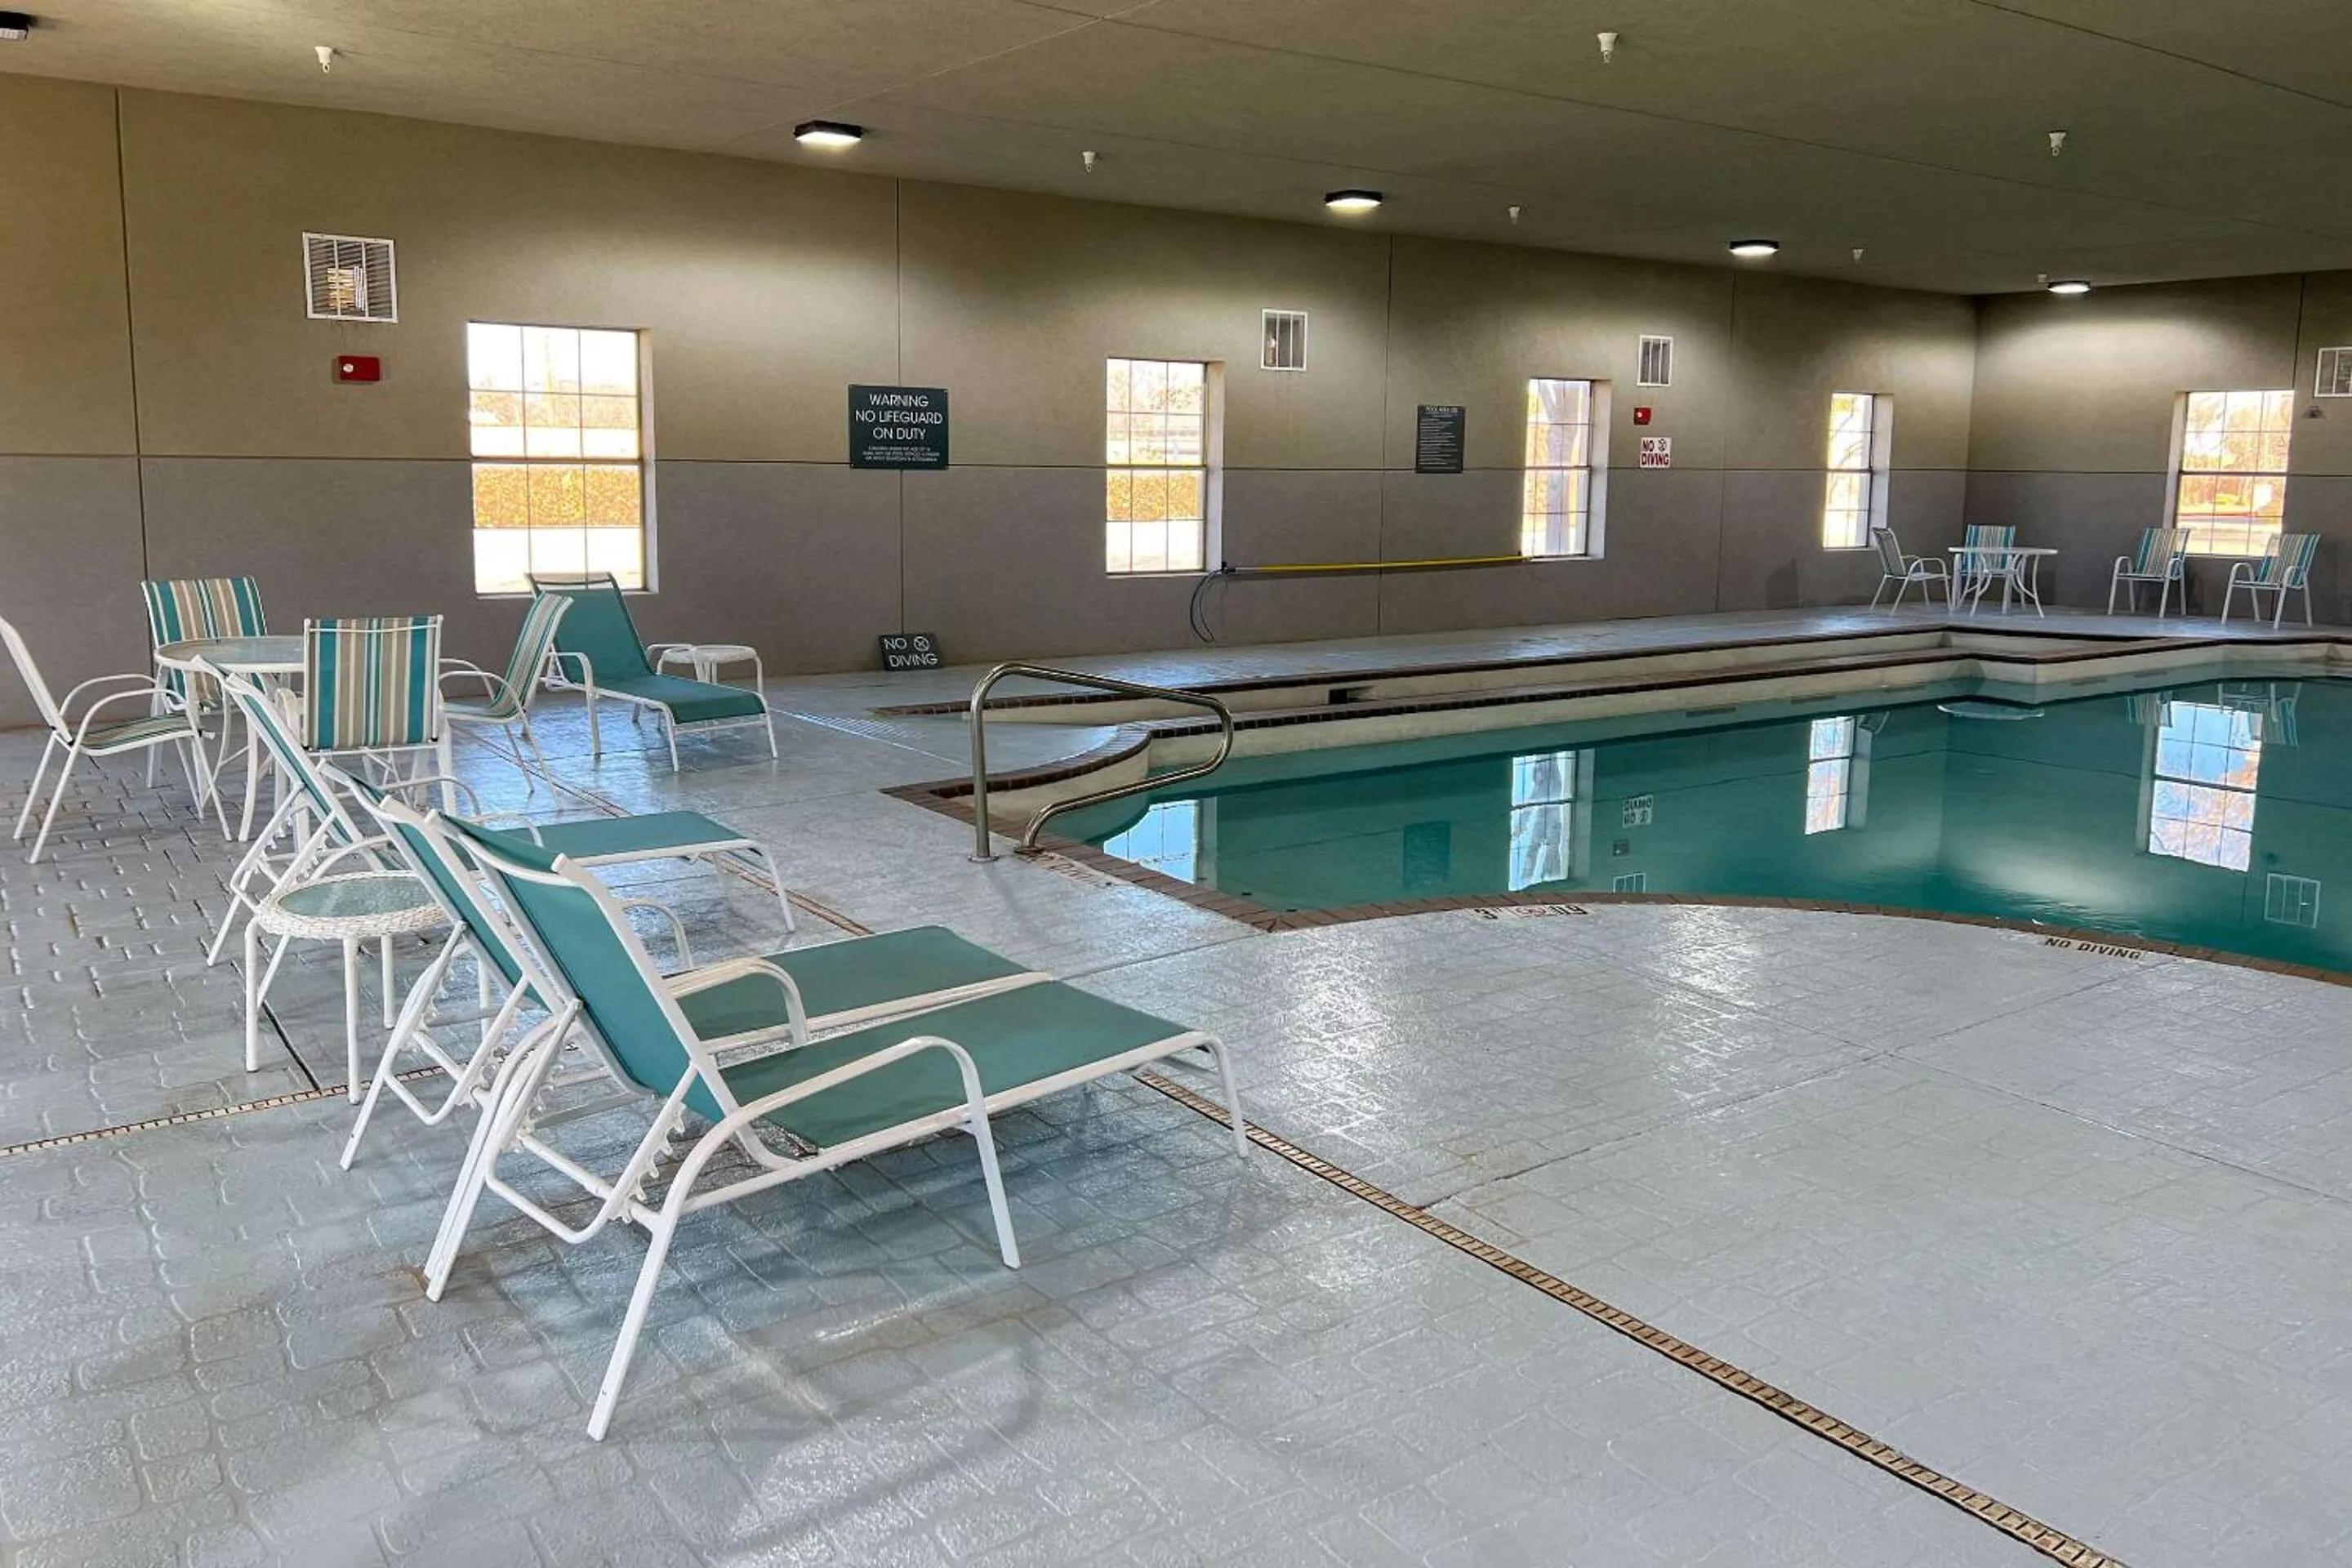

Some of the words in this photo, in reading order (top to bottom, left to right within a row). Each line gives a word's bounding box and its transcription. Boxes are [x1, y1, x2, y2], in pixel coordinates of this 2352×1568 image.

[869, 394, 929, 407] WARNING
[855, 409, 876, 422] NO
[879, 410, 943, 424] LIFEGUARD
[873, 427, 893, 439] ON
[897, 427, 926, 439] DUTY
[1642, 439, 1655, 452] NO
[884, 637, 907, 650] NO
[889, 653, 938, 667] DIVING
[2044, 938, 2071, 948] NO
[2078, 942, 2141, 959] DIVING
